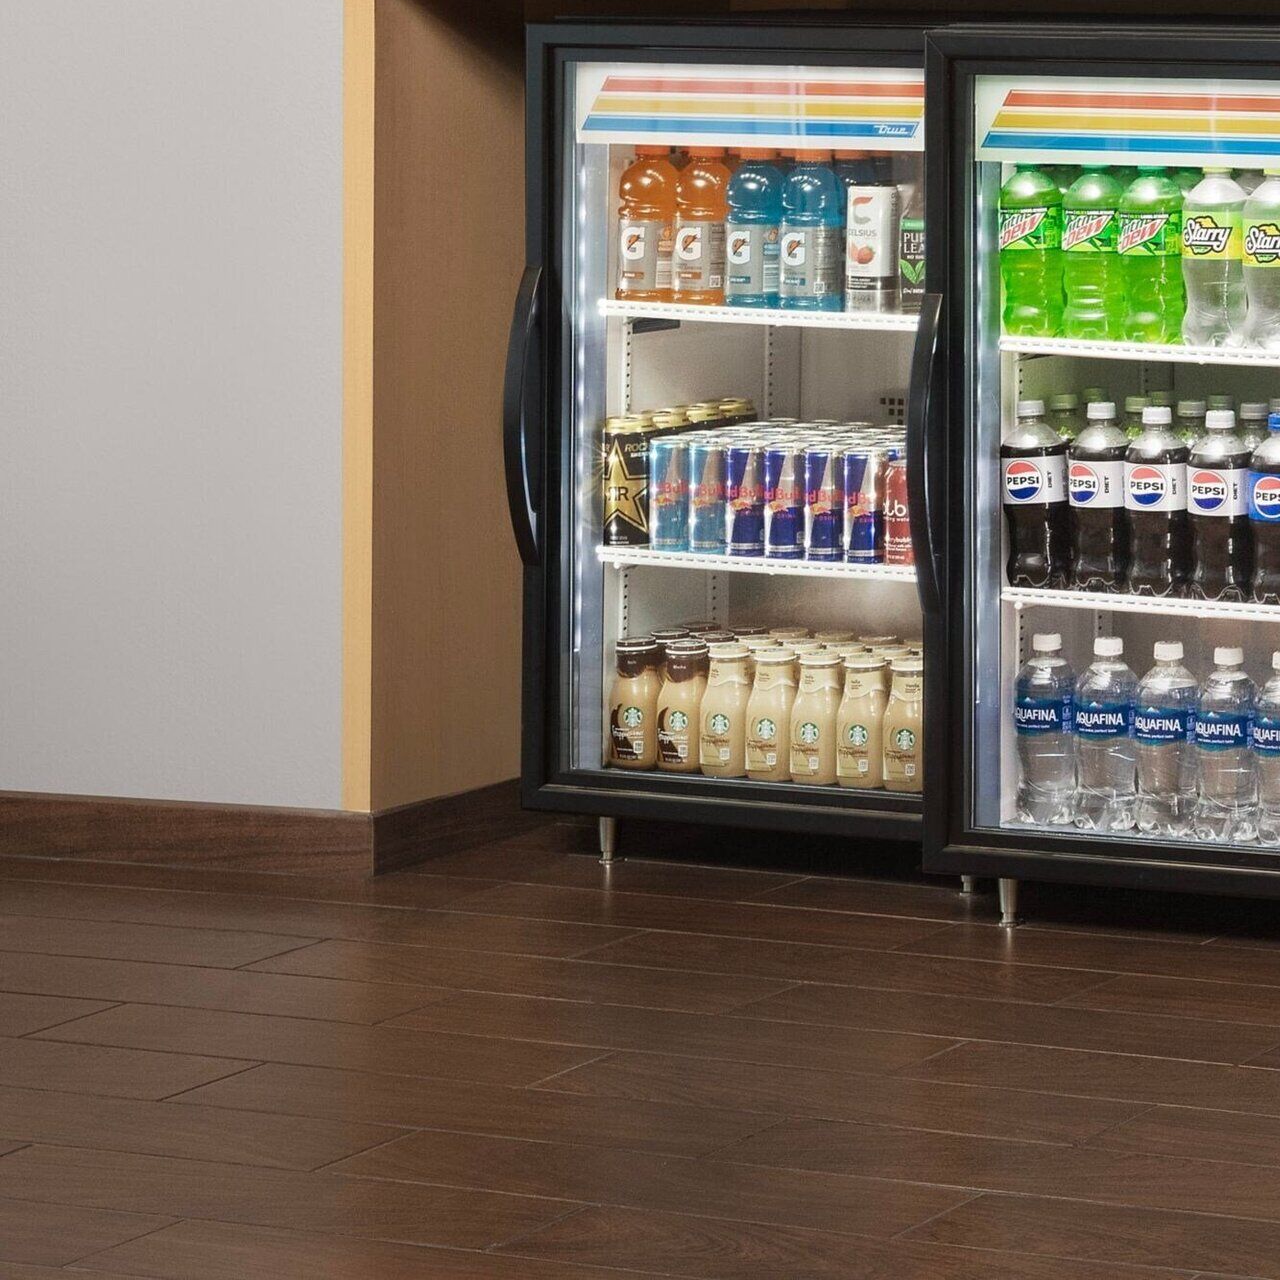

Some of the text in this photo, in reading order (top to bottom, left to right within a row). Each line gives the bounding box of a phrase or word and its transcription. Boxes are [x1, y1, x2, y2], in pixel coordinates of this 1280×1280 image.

[1185, 218, 1231, 251] Starry
[1007, 476, 1040, 485] PEPSI
[1069, 479, 1096, 489] PEPSI
[1130, 481, 1164, 491] PEPSI
[1192, 486, 1225, 496] PEPSI
